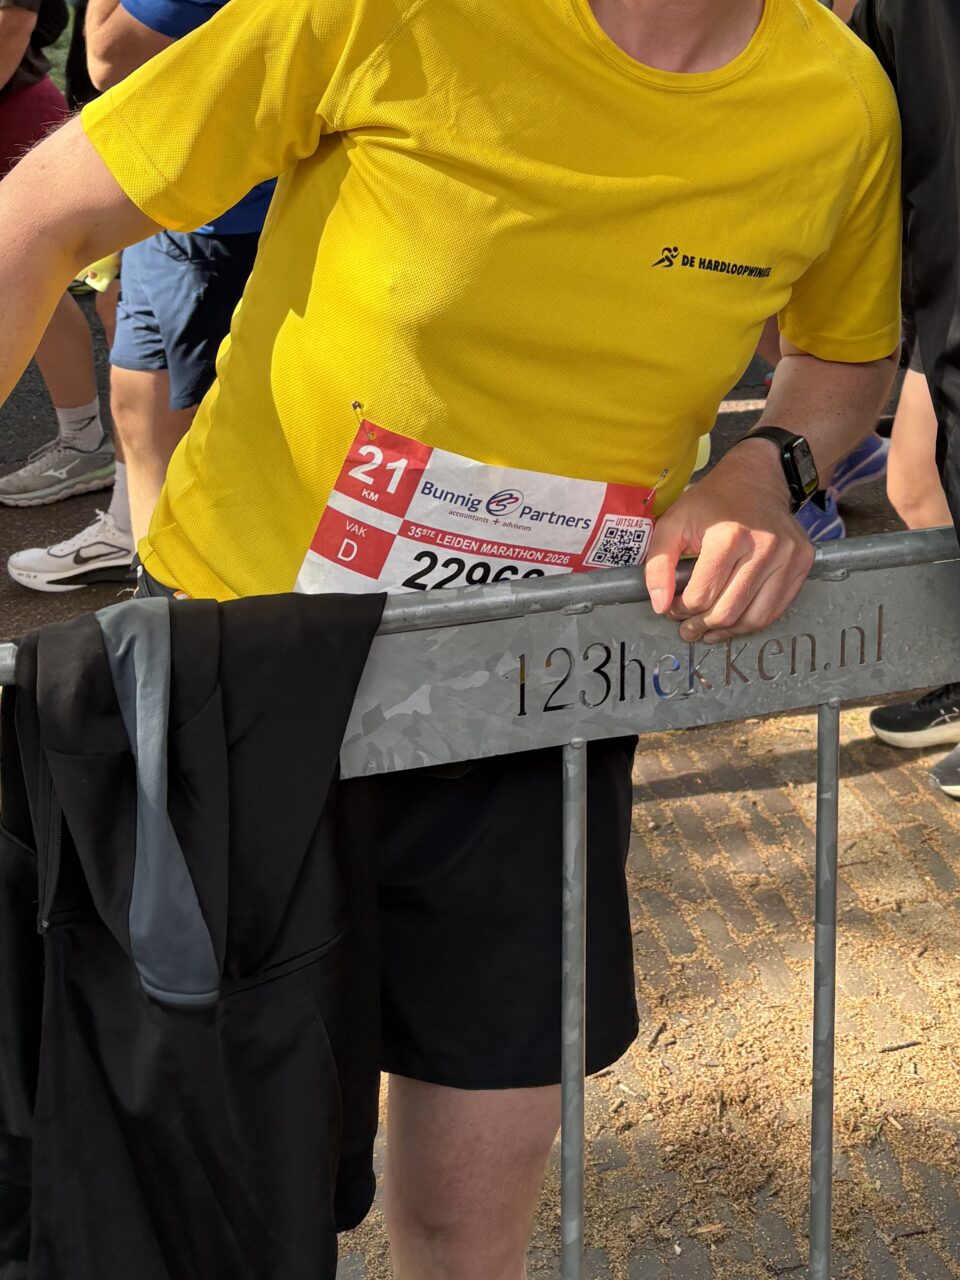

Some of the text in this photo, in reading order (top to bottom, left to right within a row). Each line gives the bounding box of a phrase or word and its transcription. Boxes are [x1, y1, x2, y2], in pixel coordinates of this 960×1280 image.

[681, 254, 696, 268] DE
[348, 444, 409, 495] 21
[361, 488, 379, 502] KM
[420, 480, 592, 530] Bunnig Partners
[345, 520, 368, 538] VAK
[448, 509, 489, 524] accountants
[502, 520, 532, 532] adviseurs
[615, 517, 644, 528] UITSLAG
[336, 537, 358, 562] D
[436, 533, 480, 552] LEIDEN
[480, 542, 545, 562] MARATHON
[544, 553, 570, 565] 2026
[402, 550, 545, 591] 229
[516, 604, 884, 716] 123hekken.nl
